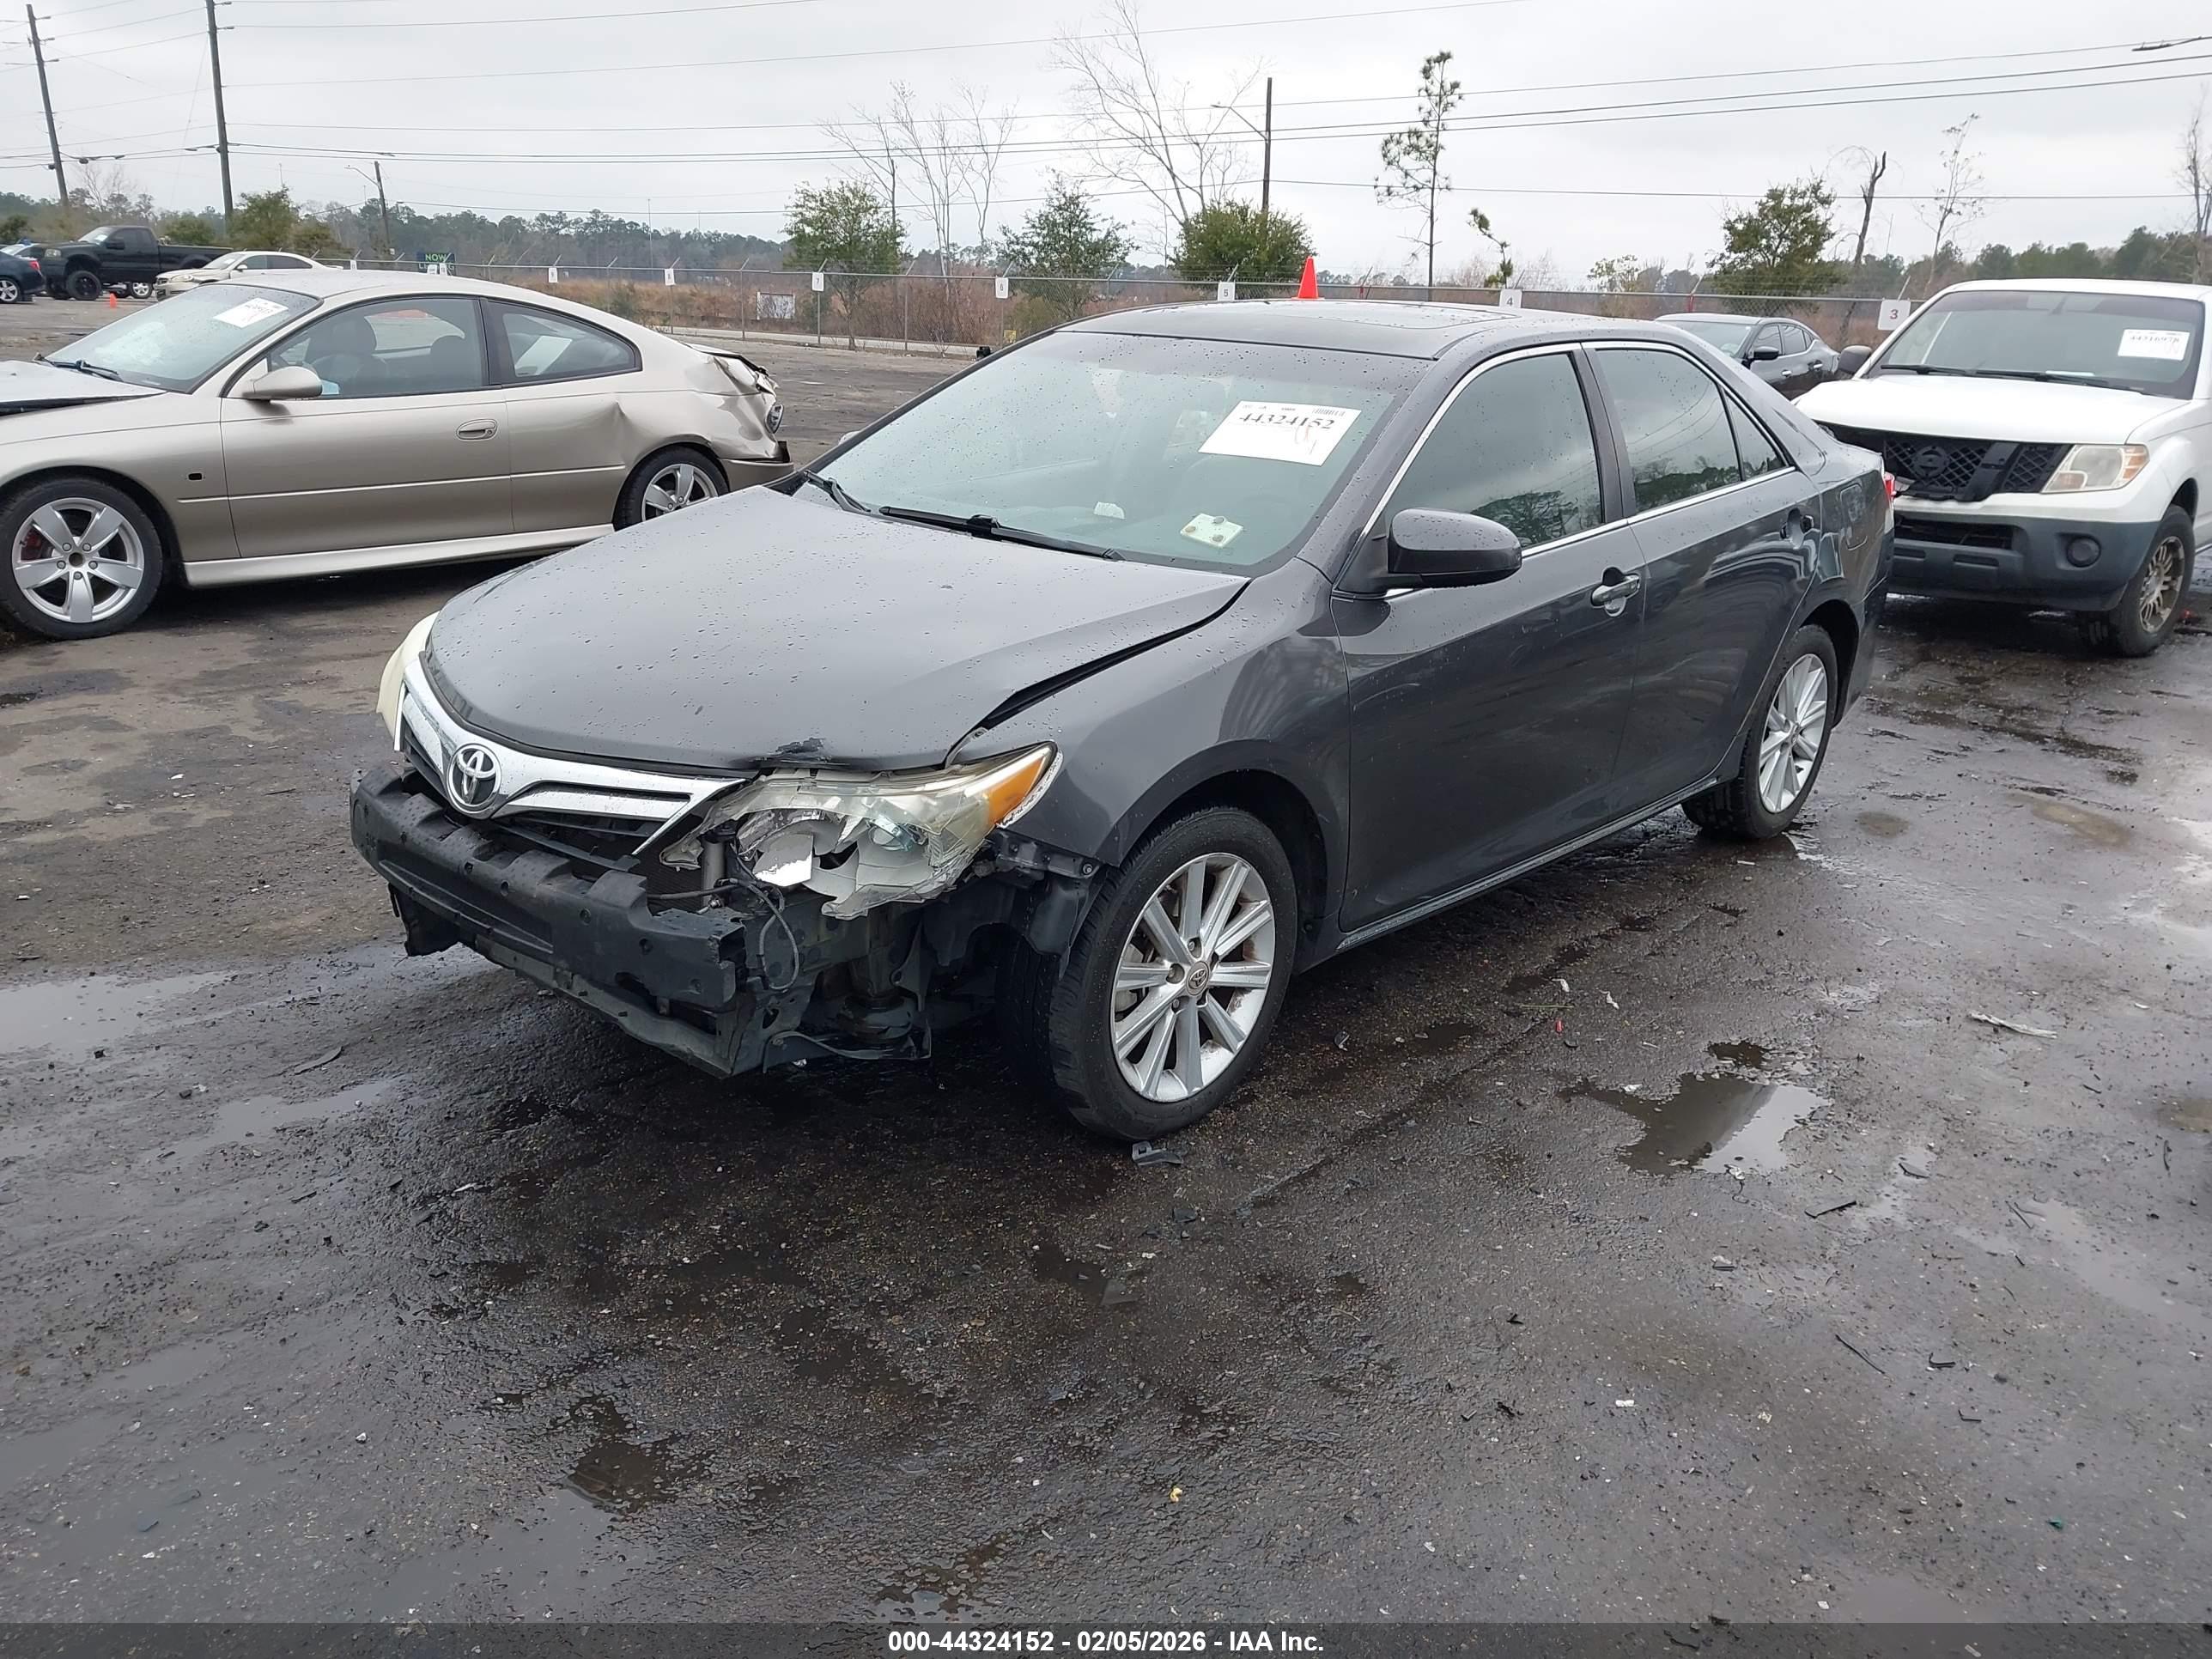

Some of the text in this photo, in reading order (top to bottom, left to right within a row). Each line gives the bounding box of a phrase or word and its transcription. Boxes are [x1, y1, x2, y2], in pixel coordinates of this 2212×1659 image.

[425, 253, 447, 262] NOW
[1223, 289, 1229, 297] 5
[1506, 296, 1513, 307] 4
[1889, 308, 1899, 319] 3
[1239, 412, 1335, 429] 44324152
